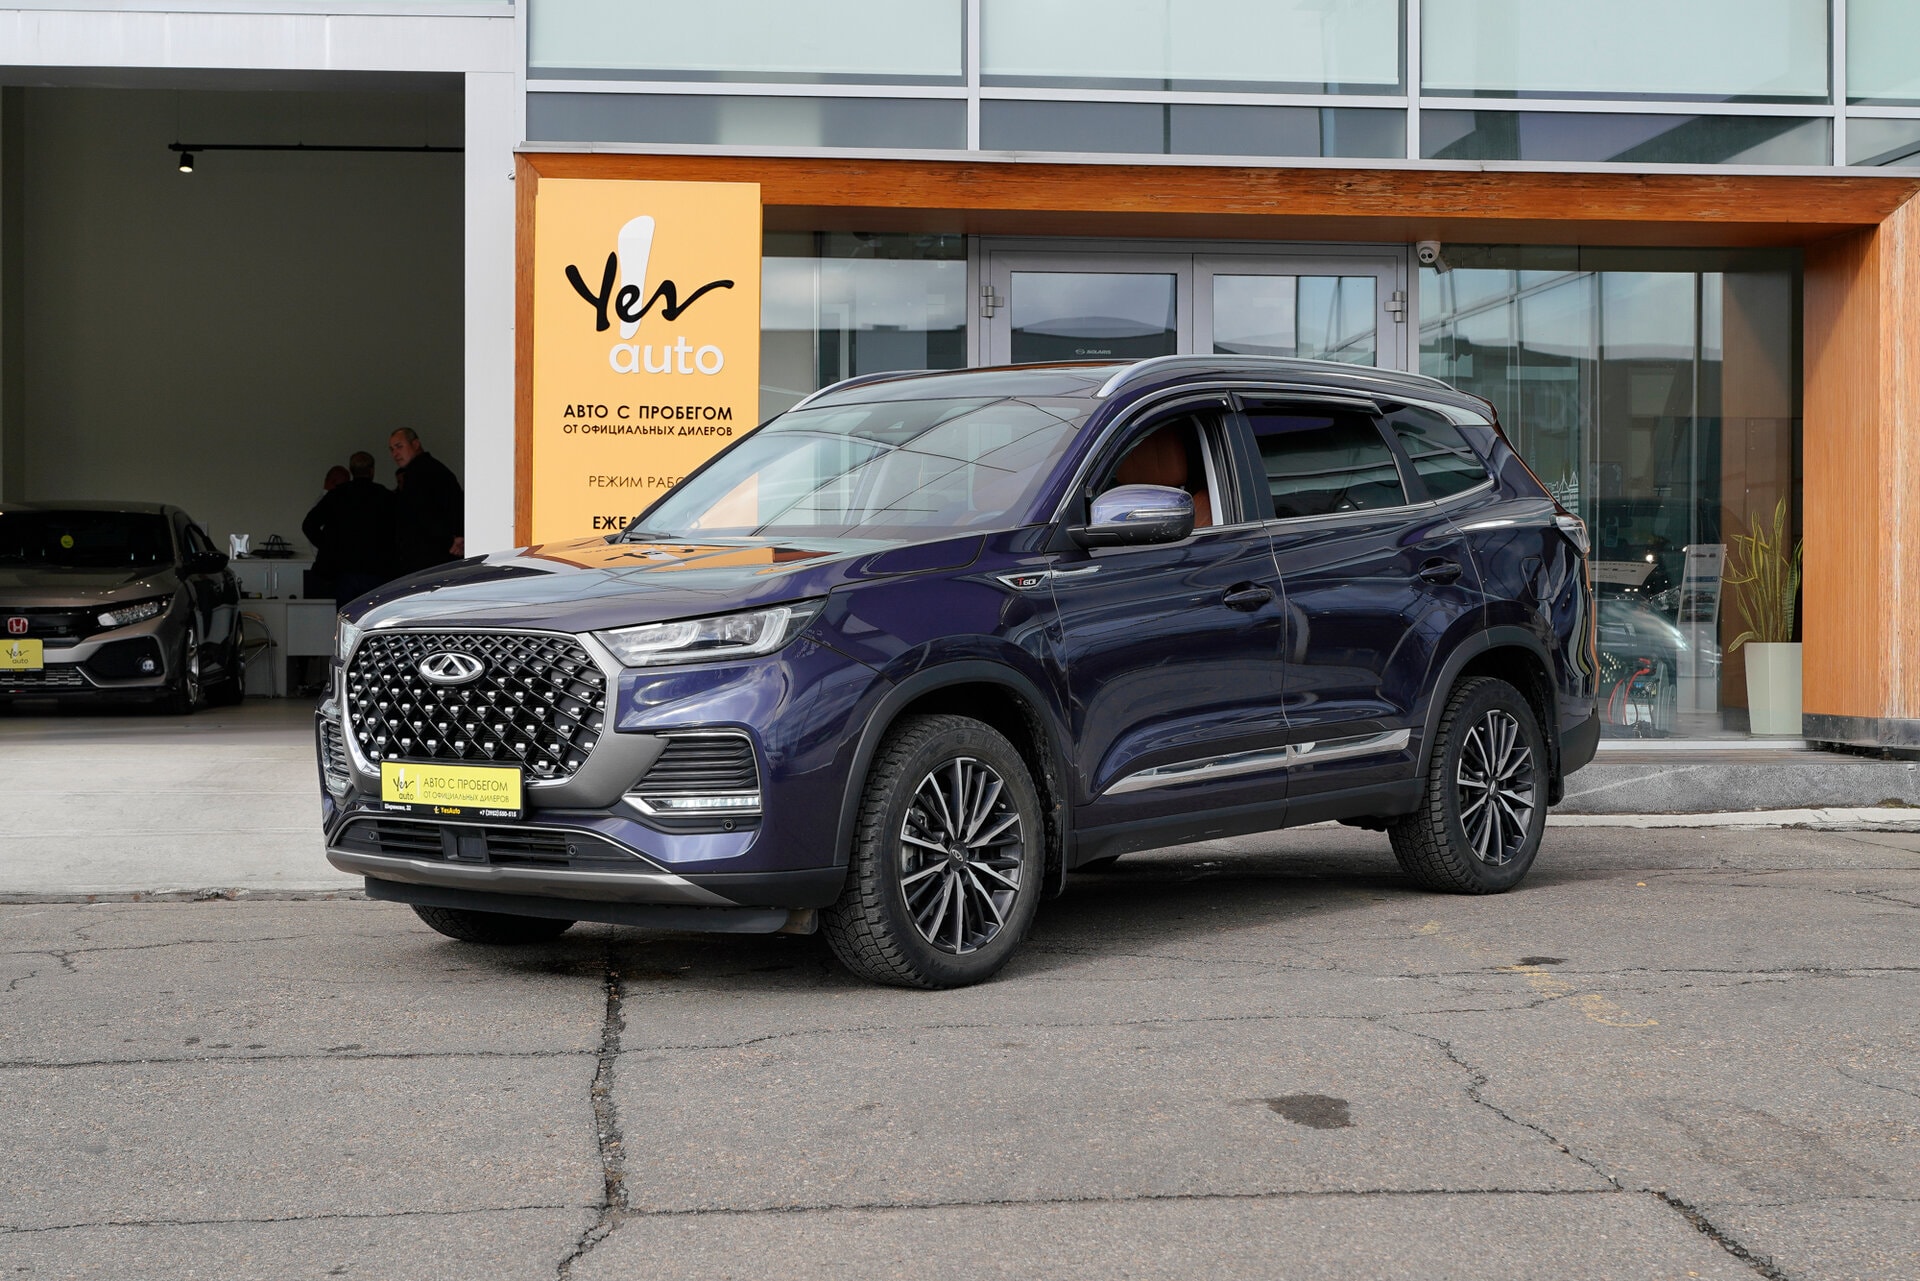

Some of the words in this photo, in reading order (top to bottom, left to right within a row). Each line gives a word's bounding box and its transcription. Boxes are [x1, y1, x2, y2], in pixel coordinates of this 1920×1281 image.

[565, 251, 735, 332] Yes
[609, 335, 725, 375] auto
[563, 404, 609, 419] АВТО
[617, 405, 631, 419] С
[638, 405, 733, 421] ПРОБЕГОМ
[563, 424, 578, 434] ОТ
[581, 424, 675, 436] ОФИЦИАЛЬНЫХ
[678, 426, 733, 437] ДИЛЕРОВ
[589, 475, 643, 488] РЕЖИМ
[592, 515, 636, 530] ЕЖЕ
[424, 778, 446, 788] АВТО
[447, 778, 456, 789] С
[457, 779, 508, 792] ПРОБЕГОМ
[432, 791, 478, 801] ОФИЦИАЛЬНЫХ
[479, 794, 510, 803] ДИЛЕРОВ
